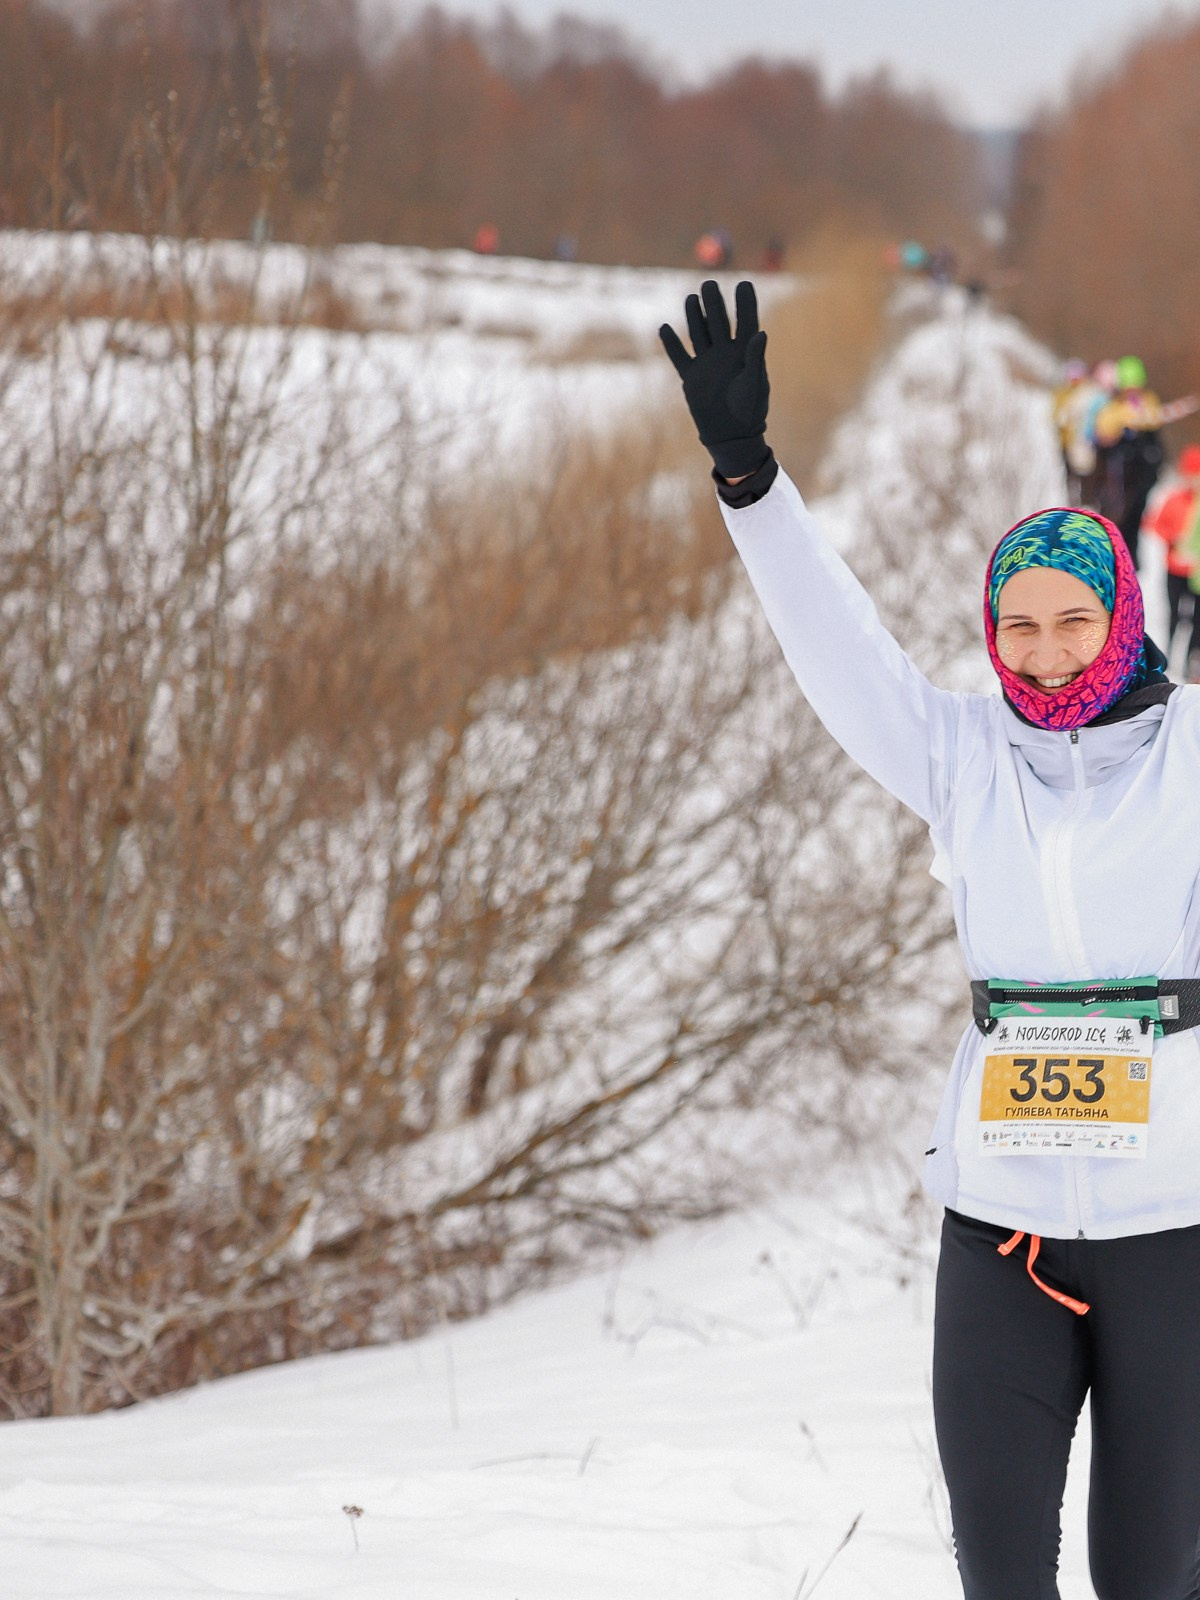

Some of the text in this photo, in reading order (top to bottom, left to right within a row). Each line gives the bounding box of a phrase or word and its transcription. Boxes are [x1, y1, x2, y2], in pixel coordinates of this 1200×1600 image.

[1015, 1025, 1107, 1044] NOVGOROD ICE
[1009, 1058, 1106, 1104] 353
[1005, 1106, 1109, 1119] ГУЛЯЕВА ТАТЬЯНА
